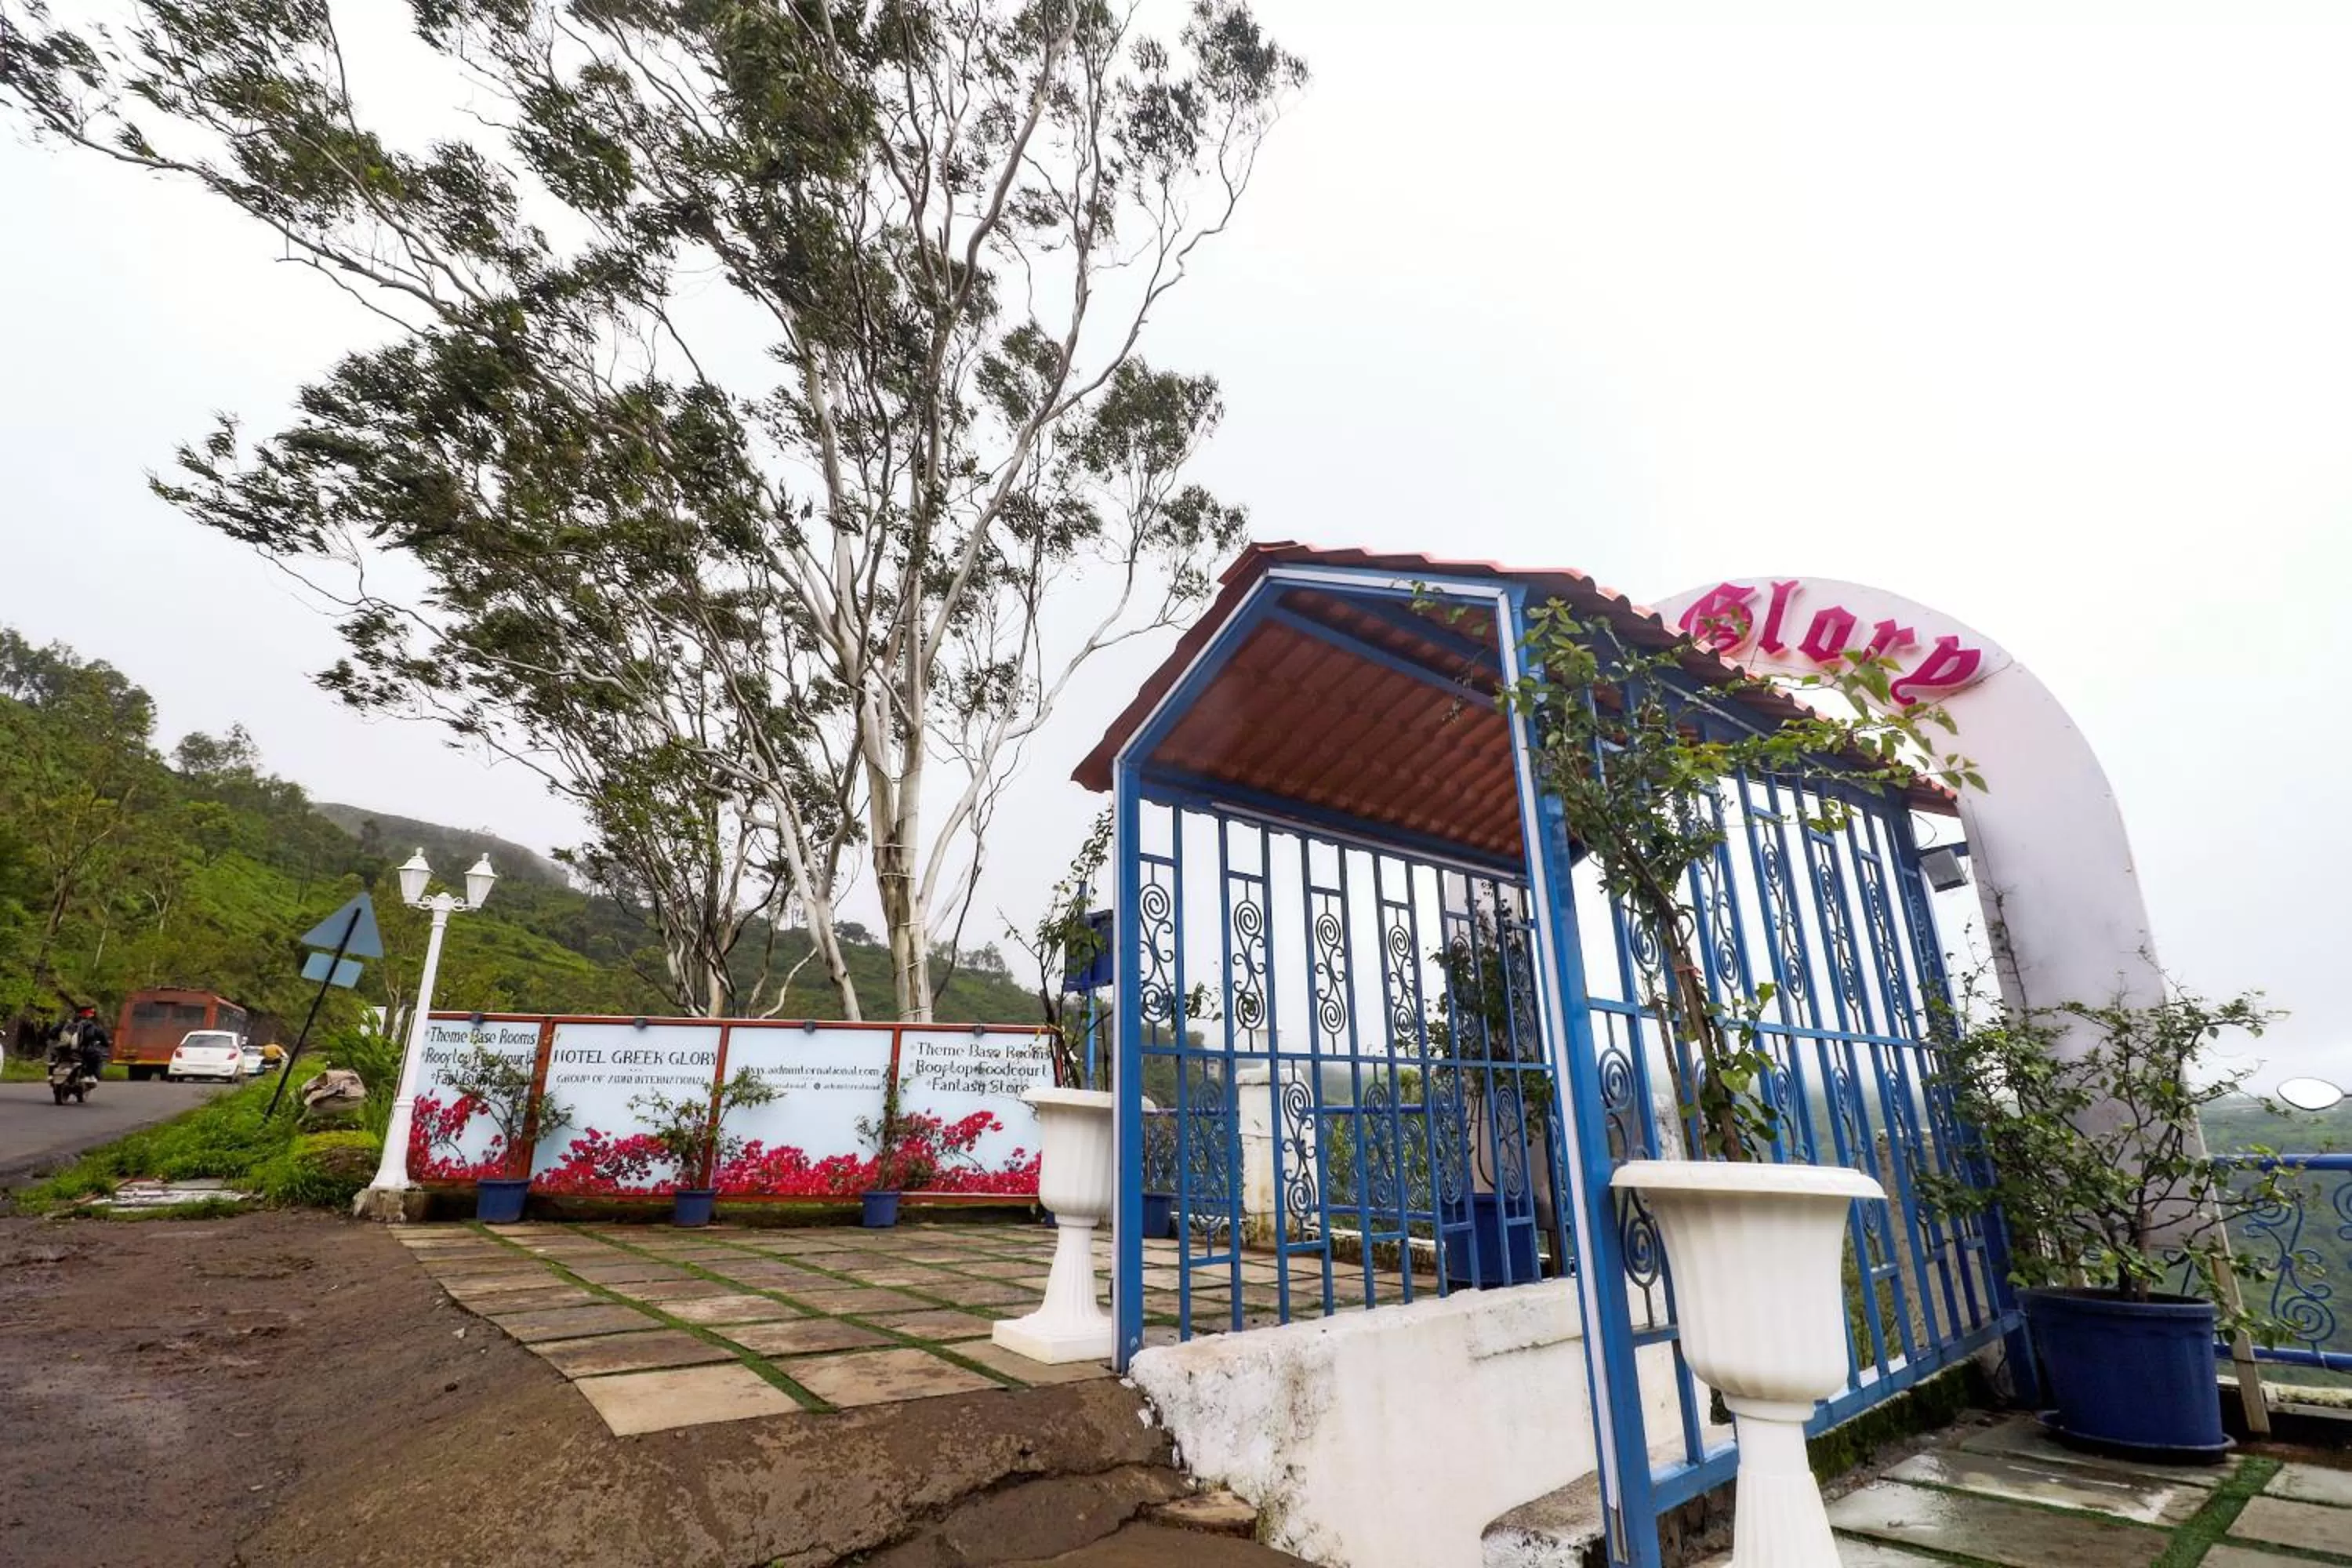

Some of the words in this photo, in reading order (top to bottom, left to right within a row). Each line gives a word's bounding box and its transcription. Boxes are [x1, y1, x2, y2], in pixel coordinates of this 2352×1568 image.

[1678, 579, 1982, 706] Glory
[430, 1026, 468, 1044] Theme
[470, 1028, 495, 1044] Base
[499, 1028, 535, 1044] Rooms
[553, 1050, 606, 1064] HOTEL
[612, 1050, 663, 1065] GREEK
[669, 1051, 717, 1065] GLORY
[917, 1042, 964, 1056] Theme
[969, 1044, 1000, 1058] Base
[1006, 1045, 1051, 1059] Rooms
[916, 1059, 973, 1077] Rooftop
[977, 1061, 1047, 1077] Foodcourt
[931, 1077, 986, 1095] Fantasy
[989, 1079, 1029, 1094] Store
